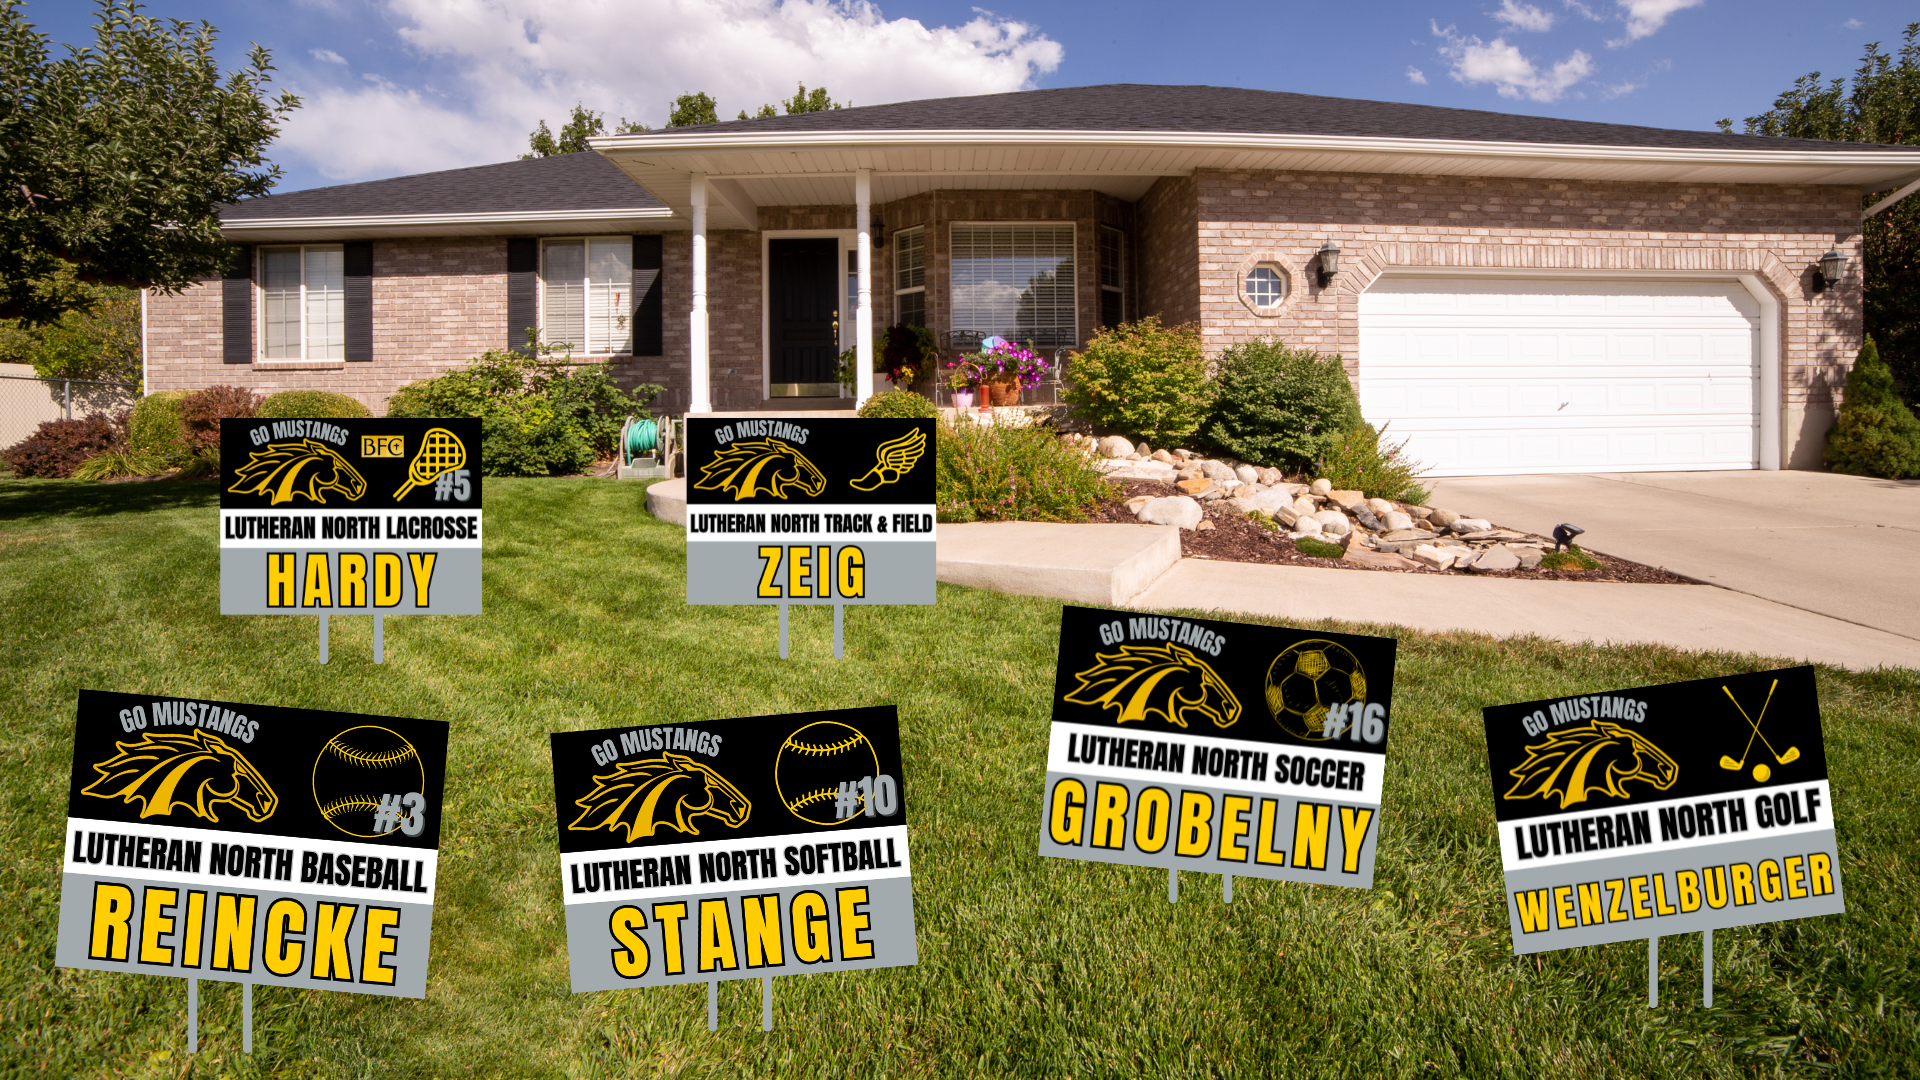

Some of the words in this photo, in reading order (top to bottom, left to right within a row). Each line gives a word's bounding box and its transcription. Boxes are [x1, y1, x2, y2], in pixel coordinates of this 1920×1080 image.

[250, 426, 270, 446] GO
[272, 419, 349, 446] MUSTANGS
[714, 425, 734, 445] GO
[736, 420, 809, 445] MUSTANGS
[435, 469, 471, 501] #5
[225, 516, 316, 539] LUTHERAN
[322, 516, 380, 539] NORTH
[386, 516, 478, 539] LACROSSE
[690, 513, 766, 533] LUTHERAN
[771, 513, 820, 533] NORTH
[824, 513, 873, 533] TRACK
[877, 515, 888, 533] &
[892, 513, 932, 533] FIELD
[267, 552, 438, 608] HARDY
[757, 545, 865, 599] ZEIG
[1100, 620, 1123, 646] GO
[1129, 617, 1226, 657] MUSTANGS
[119, 705, 147, 733] GO
[152, 701, 259, 744] MUSTANGS
[1322, 701, 1386, 744] #16
[1522, 710, 1549, 737] GO
[1549, 696, 1648, 727] MUSTANGS
[591, 739, 617, 766] GO
[620, 727, 722, 764] MUSTANGS
[1067, 733, 1186, 773] LUTHERAN
[1192, 745, 1268, 781] NORTH
[1274, 754, 1365, 791] SOCCER
[373, 791, 426, 837] #3
[835, 774, 898, 820] #10
[1049, 777, 1375, 875] GROBELNY
[1514, 810, 1652, 861] LUTHERAN
[1658, 797, 1748, 842] NORTH
[1755, 788, 1821, 829] GOLF
[72, 830, 202, 873] LUTHERAN
[209, 842, 293, 882] NORTH
[301, 851, 428, 894] BASEBALL
[570, 854, 692, 894] LUTHERAN
[698, 847, 778, 883] NORTH
[785, 837, 901, 876] SOFTBALL
[1514, 852, 1834, 934] WENZELBURGER
[88, 881, 401, 986] REINCKE
[609, 885, 875, 980] STANGE
